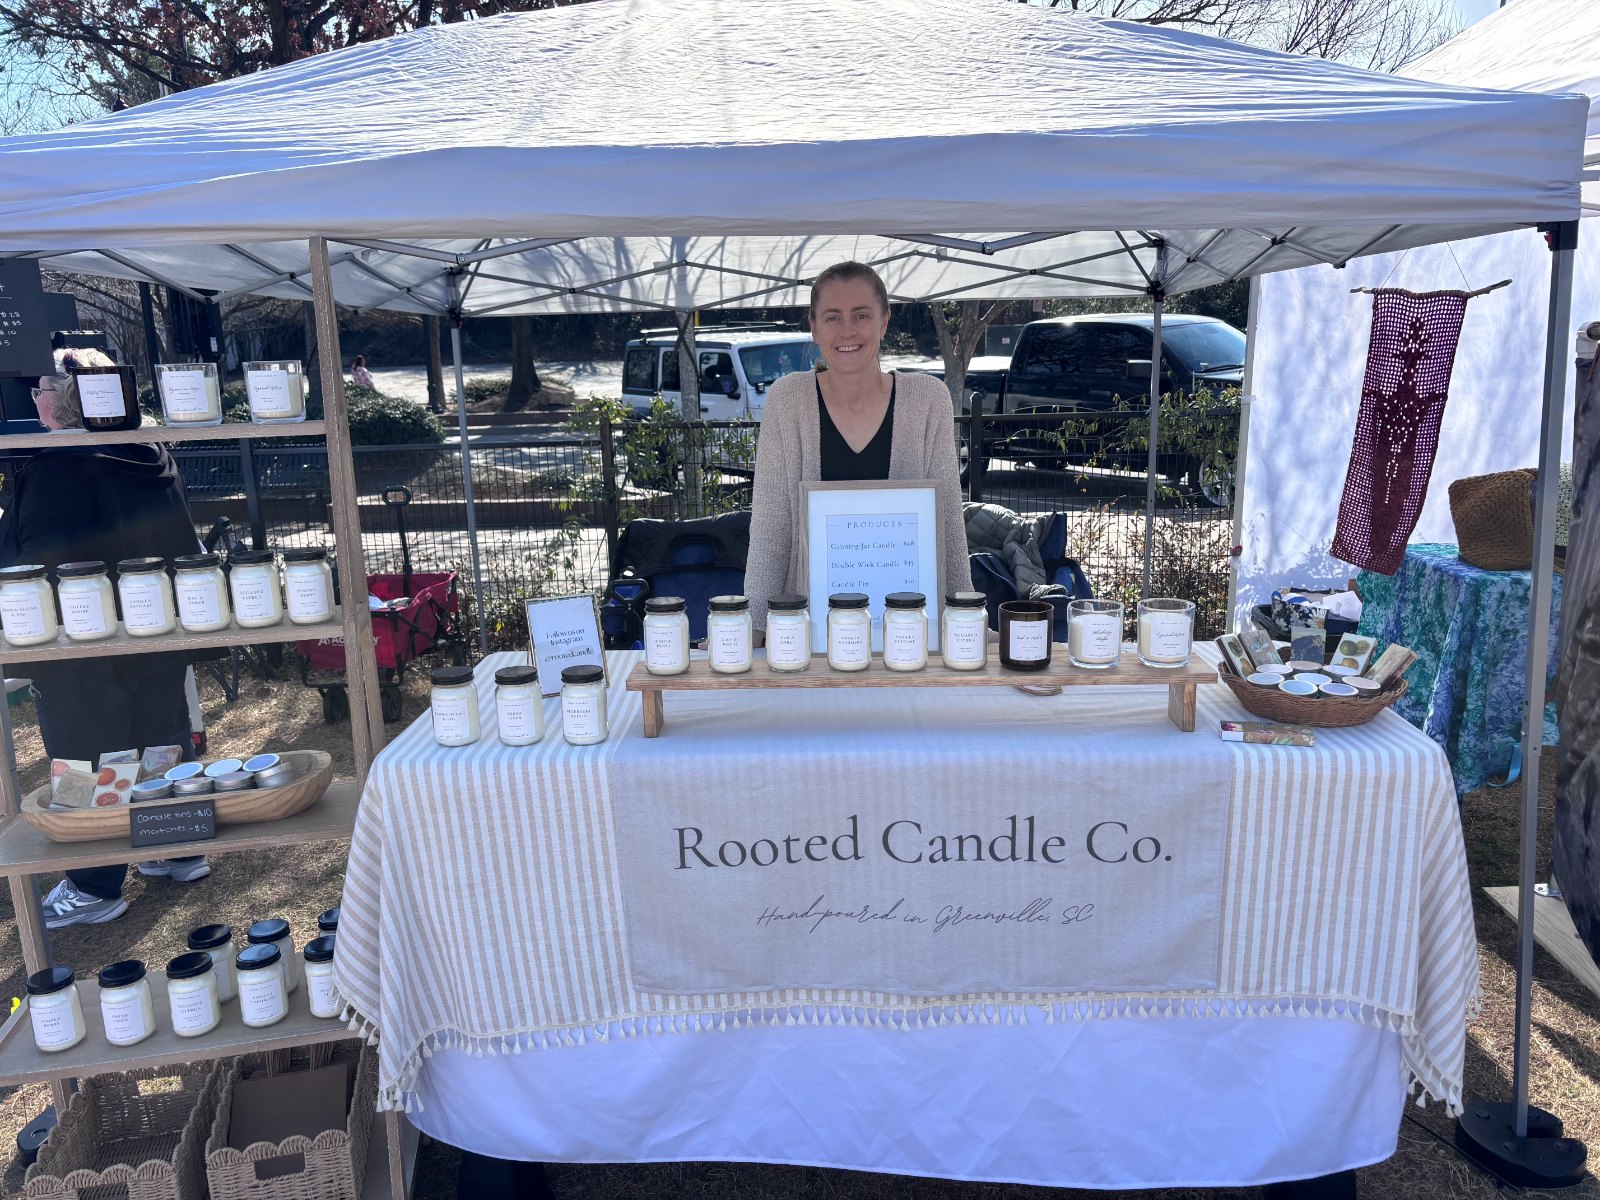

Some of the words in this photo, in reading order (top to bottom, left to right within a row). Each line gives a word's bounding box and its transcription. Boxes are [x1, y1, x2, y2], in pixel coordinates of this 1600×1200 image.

[847, 520, 902, 528] PRODUCTS
[830, 543, 860, 551] Canning
[860, 542, 871, 550] Jar
[872, 541, 896, 549] Candle
[876, 560, 900, 568] Candle
[831, 580, 855, 588] Candle
[546, 630, 567, 639] Follow
[550, 636, 584, 646] Instagram
[137, 812, 172, 824] Candle
[174, 810, 192, 818] tins
[140, 825, 186, 836] matches
[673, 814, 865, 869] Rooted
[882, 814, 1066, 863] Candle
[1086, 821, 1172, 863] Co.
[903, 913, 928, 924] in
[1061, 903, 1095, 925] SC
